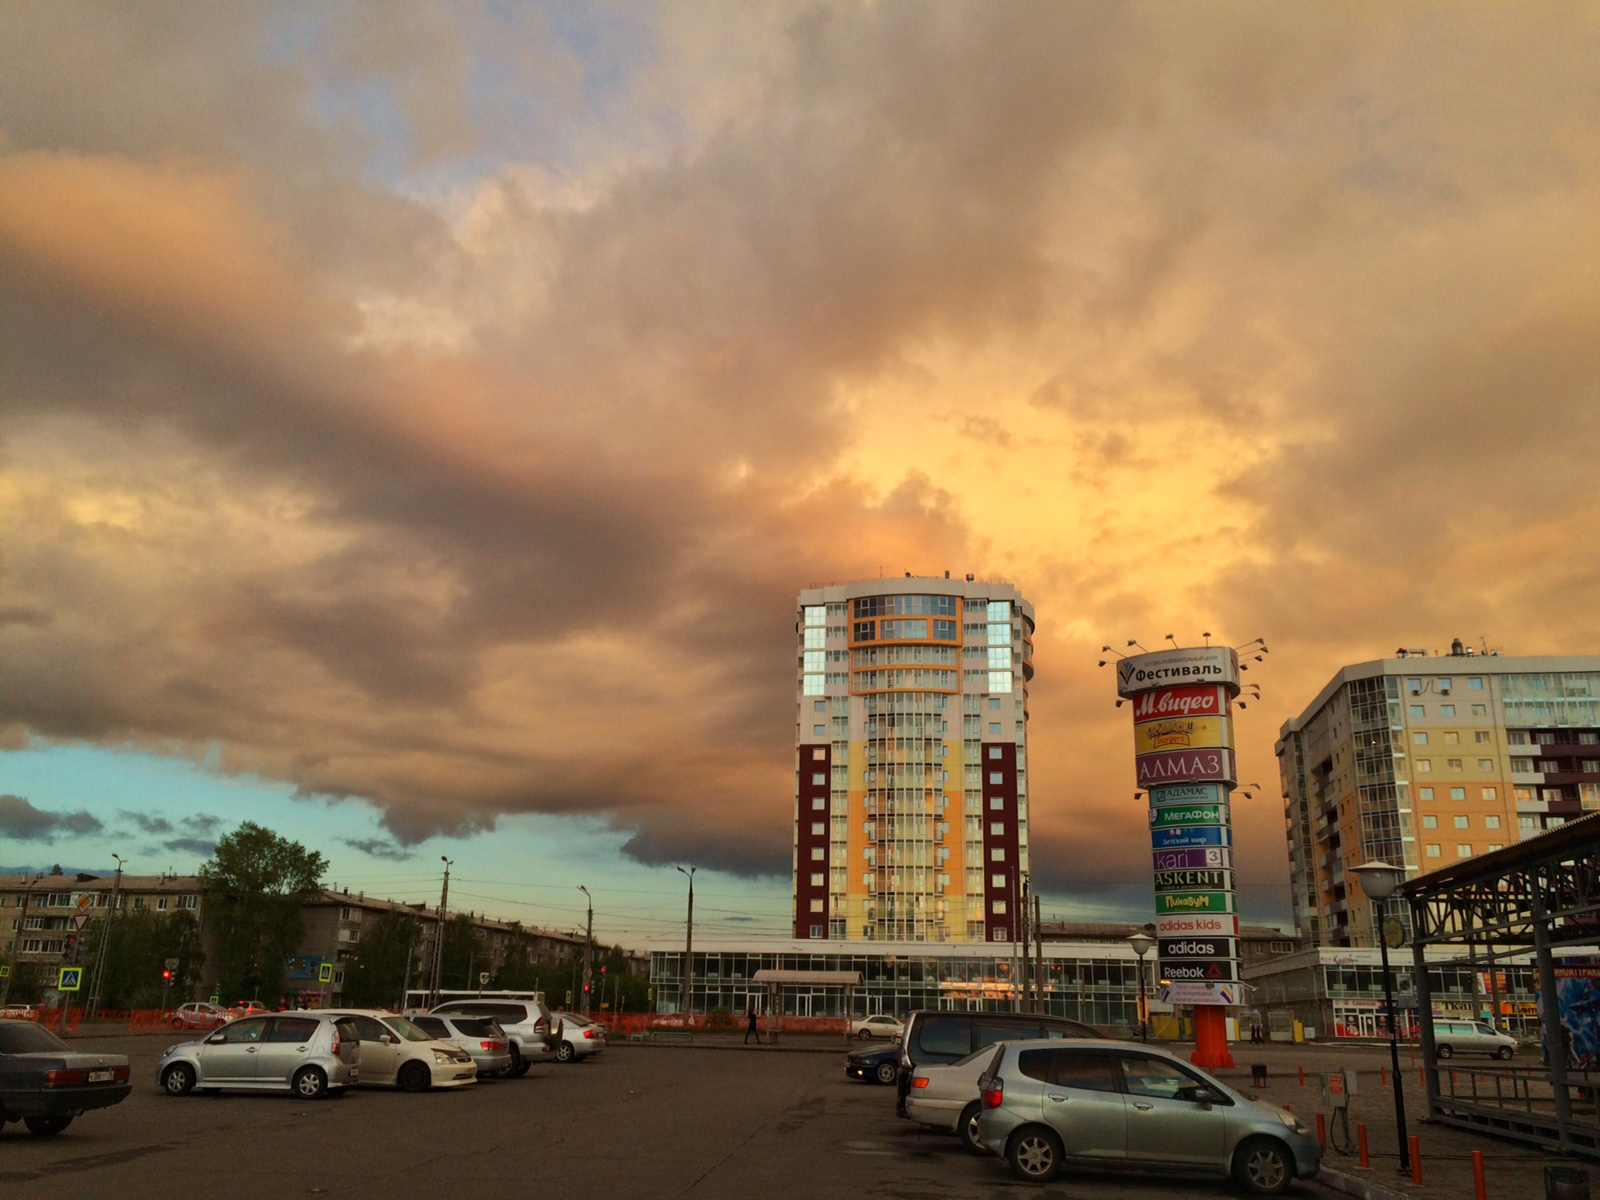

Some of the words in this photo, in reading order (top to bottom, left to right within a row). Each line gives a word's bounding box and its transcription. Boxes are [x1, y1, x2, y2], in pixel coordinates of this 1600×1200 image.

[1136, 665, 1222, 682] Фестиваль
[1136, 692, 1214, 717] М.видео
[1140, 755, 1220, 780] АЛМАЗ
[1167, 787, 1208, 797] АДАМАС
[1162, 837, 1189, 845] Детский
[1190, 837, 1207, 845] мир
[1156, 849, 1189, 869] kari
[1208, 850, 1218, 862] 3
[1155, 871, 1221, 886] ASKENT
[1159, 920, 1194, 931] adidas
[1195, 919, 1222, 930] kids
[1167, 941, 1215, 954] adidas
[1164, 967, 1205, 978] Reebok
